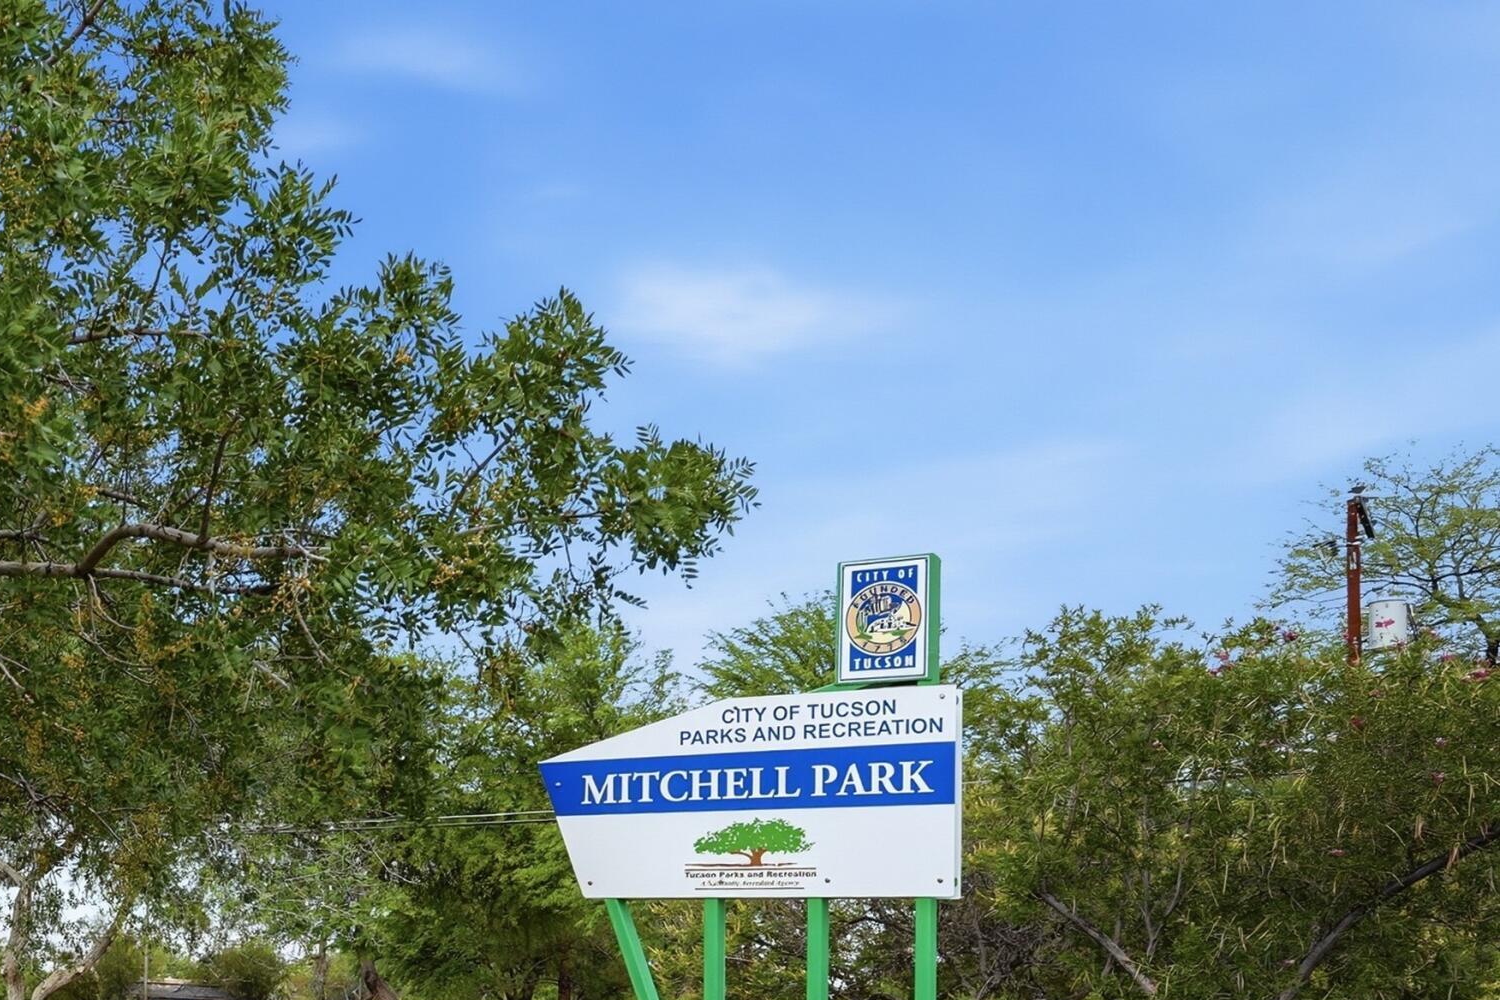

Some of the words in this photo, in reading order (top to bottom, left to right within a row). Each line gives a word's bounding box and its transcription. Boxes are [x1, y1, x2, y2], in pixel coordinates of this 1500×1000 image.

[857, 571, 888, 583] CITY
[898, 568, 914, 579] OF
[851, 585, 915, 610] FOUNDED
[853, 655, 914, 670] TUCSON
[722, 707, 766, 724] CITY
[773, 705, 800, 721] OF
[807, 699, 896, 720] TUCSON
[680, 728, 747, 746] PARKS
[752, 726, 796, 742] AND
[803, 717, 944, 740] RECREATION
[580, 765, 801, 806] MITCHELL
[810, 759, 935, 797] PARK
[684, 871, 717, 879] Tucson
